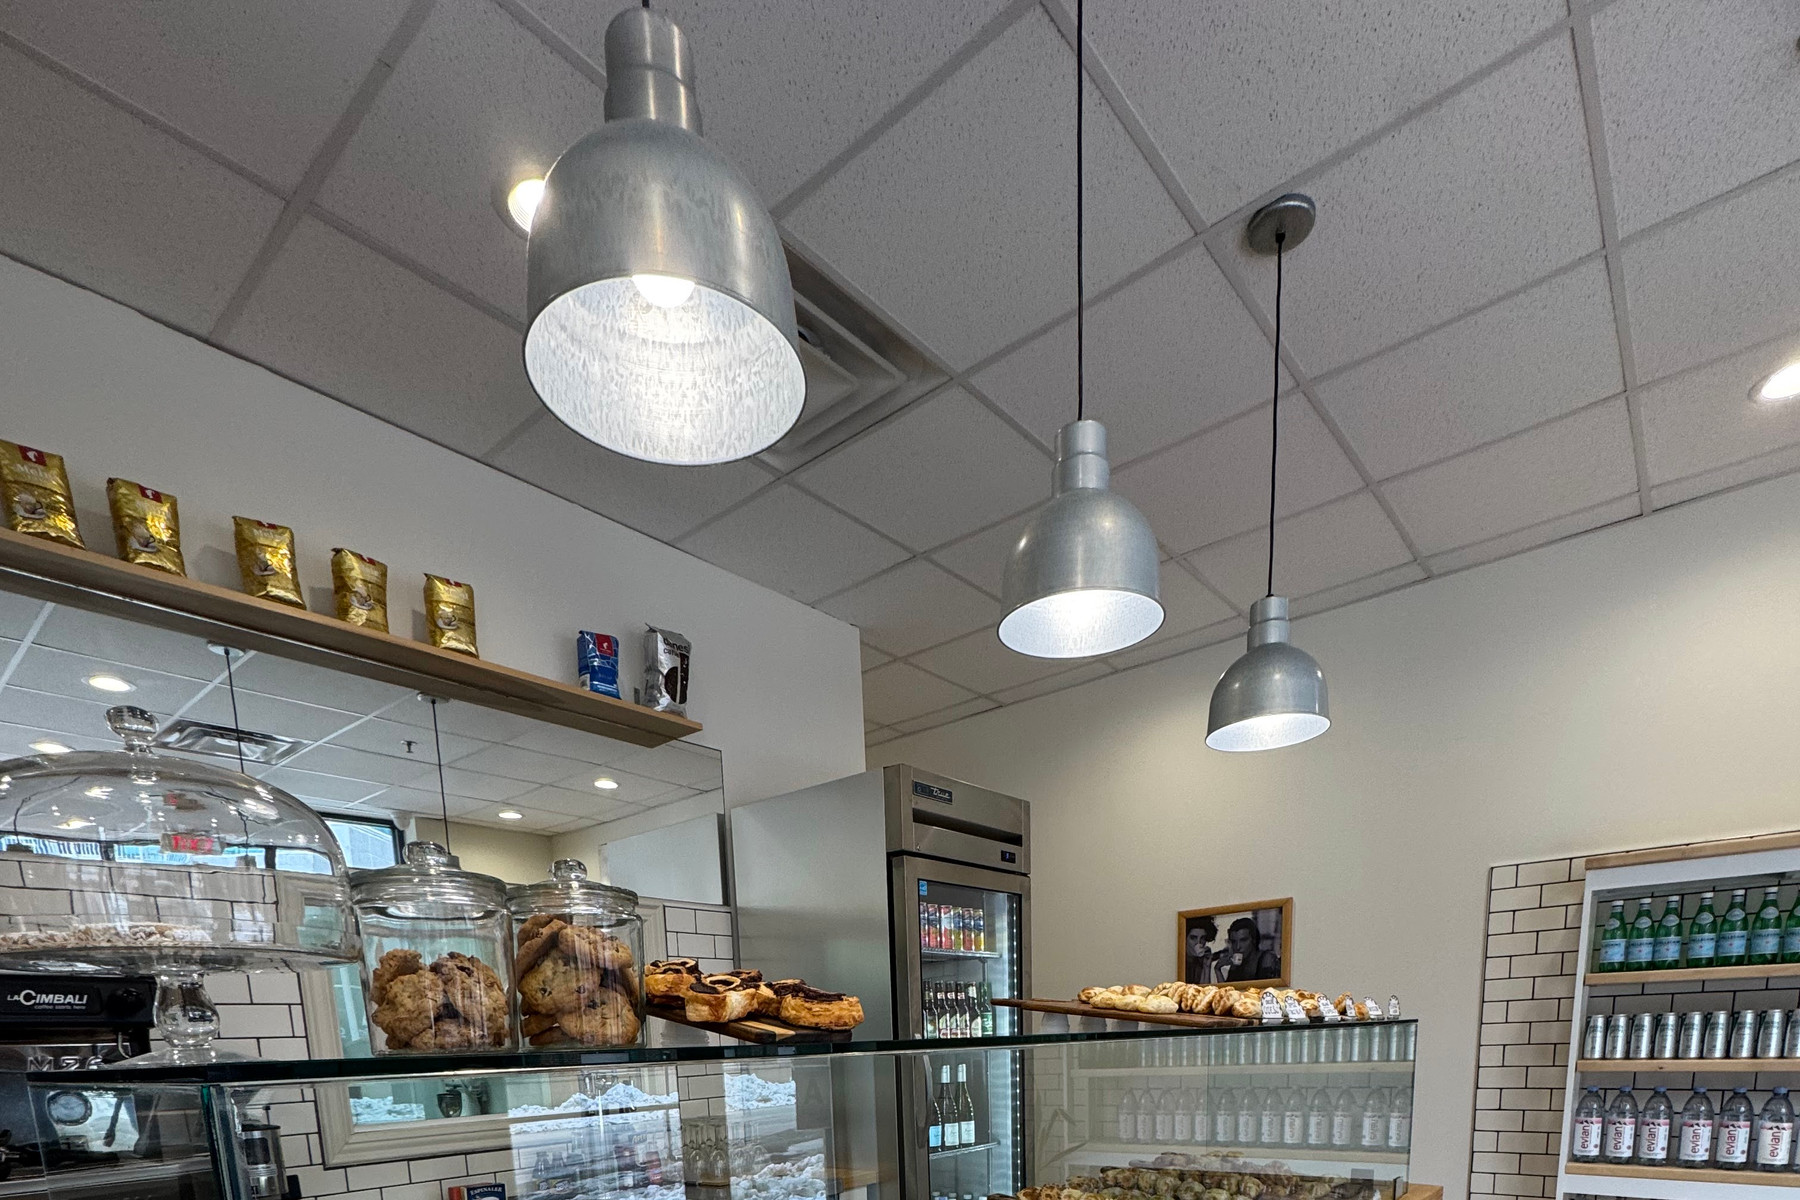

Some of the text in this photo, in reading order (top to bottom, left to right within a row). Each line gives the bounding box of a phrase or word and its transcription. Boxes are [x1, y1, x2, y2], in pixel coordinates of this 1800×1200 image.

[20, 989, 88, 1006] CIMBALI
[1581, 1124, 1590, 1149] evian
[1613, 1126, 1623, 1151] evian
[1646, 1127, 1657, 1152] evian
[1690, 1128, 1701, 1154] evian
[1725, 1129, 1737, 1155] evian
[1769, 1130, 1781, 1158] evian
